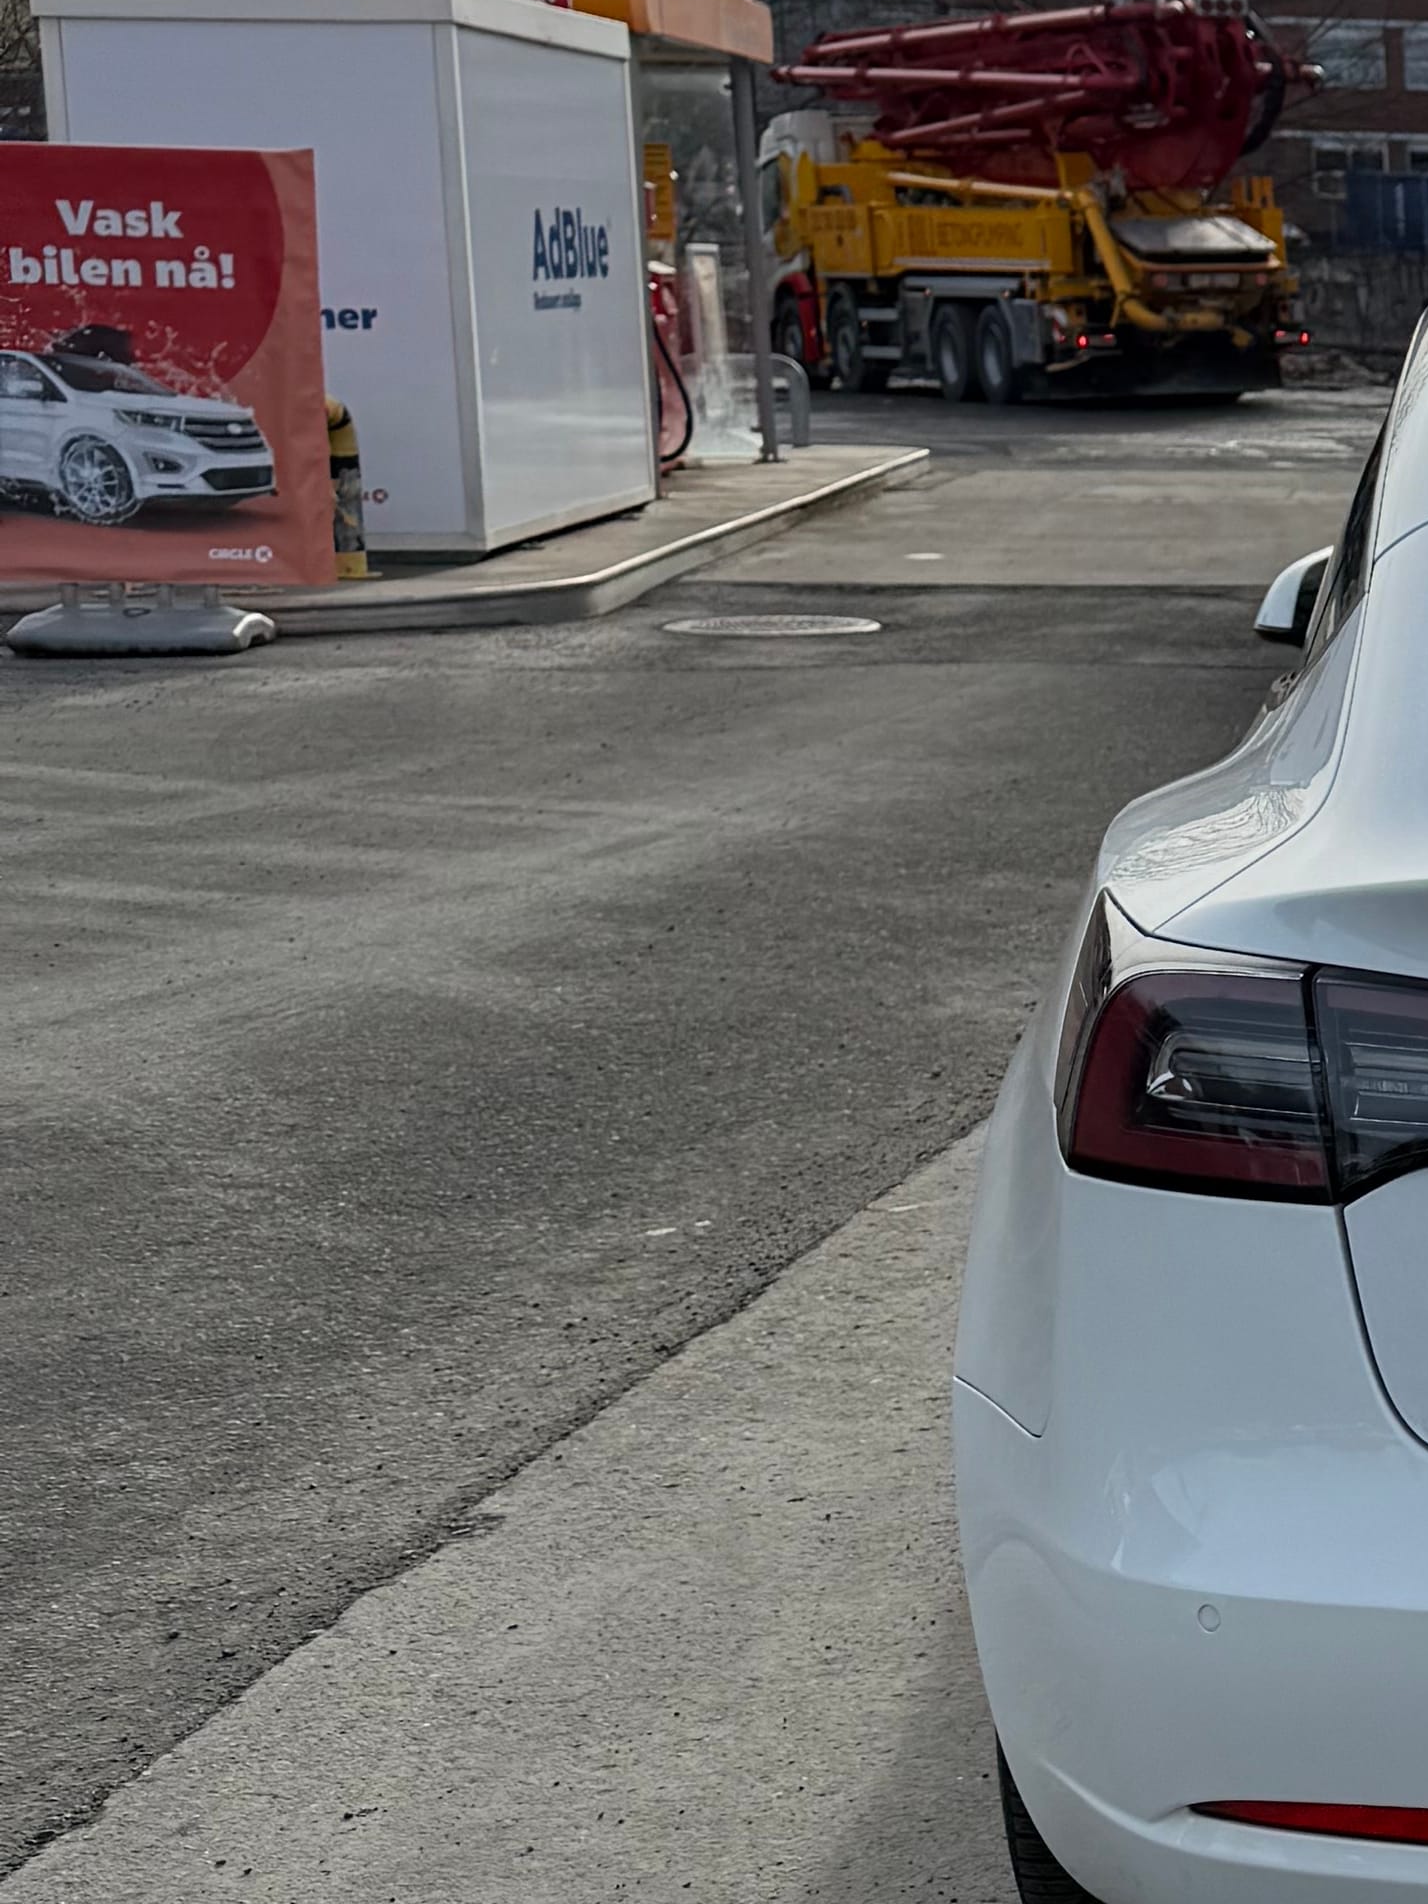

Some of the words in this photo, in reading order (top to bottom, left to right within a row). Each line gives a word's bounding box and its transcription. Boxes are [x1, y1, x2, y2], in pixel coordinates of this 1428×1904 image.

[55, 199, 184, 238] Vask
[533, 206, 609, 281] AdBlue
[9, 245, 143, 286] bilen
[155, 246, 236, 289] nå!
[208, 547, 254, 561] CIRCLE
